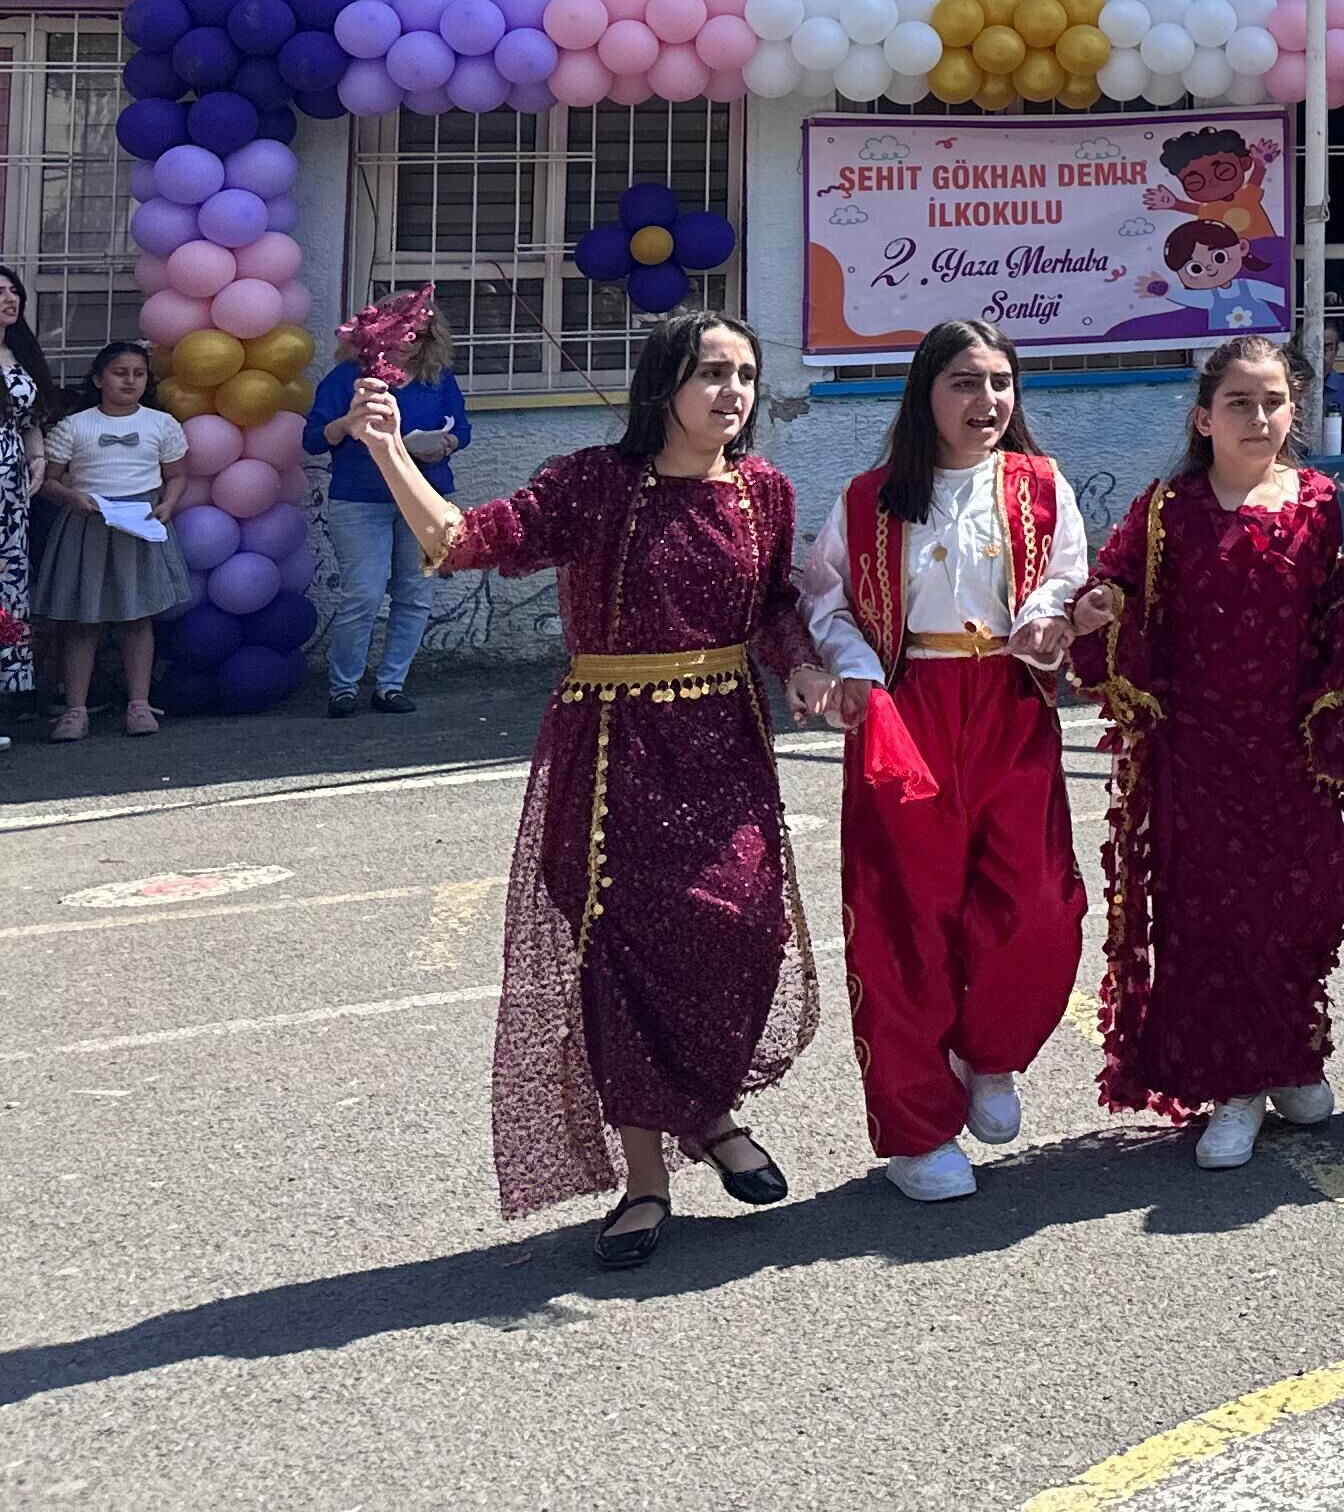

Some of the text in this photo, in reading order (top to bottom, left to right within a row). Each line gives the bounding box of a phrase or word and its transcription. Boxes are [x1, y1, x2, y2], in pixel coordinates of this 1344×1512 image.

[839, 157, 1148, 199] ŞEHİT GÖKHAN DEMİR
[928, 197, 1062, 228] İLKOKULU
[870, 236, 1109, 289] 2. Yaza Merhaba
